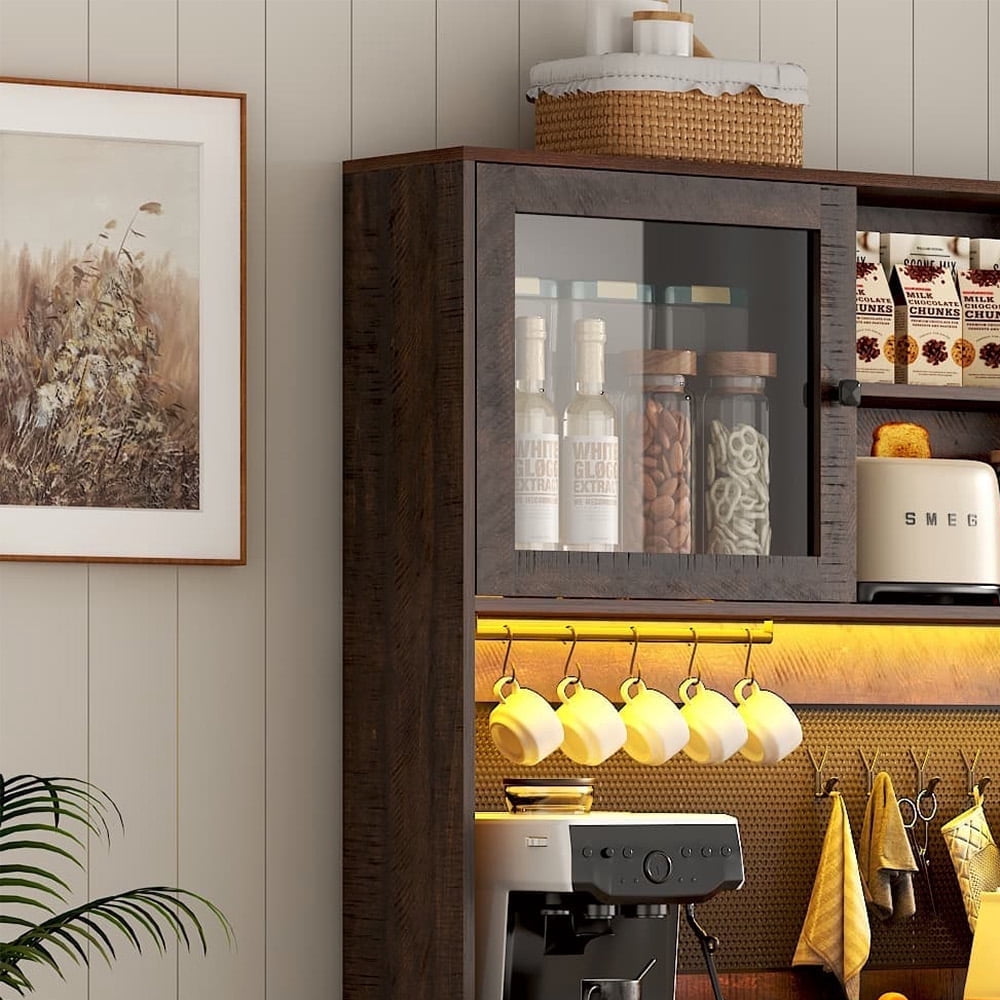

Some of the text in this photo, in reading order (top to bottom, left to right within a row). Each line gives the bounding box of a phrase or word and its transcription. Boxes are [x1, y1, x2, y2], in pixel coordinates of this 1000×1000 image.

[906, 291, 934, 299] MILK
[856, 303, 893, 313] UNKS
[908, 299, 960, 307] CHOCOLATE
[909, 306, 961, 317] CHUNKS
[905, 511, 978, 527] SMEG
